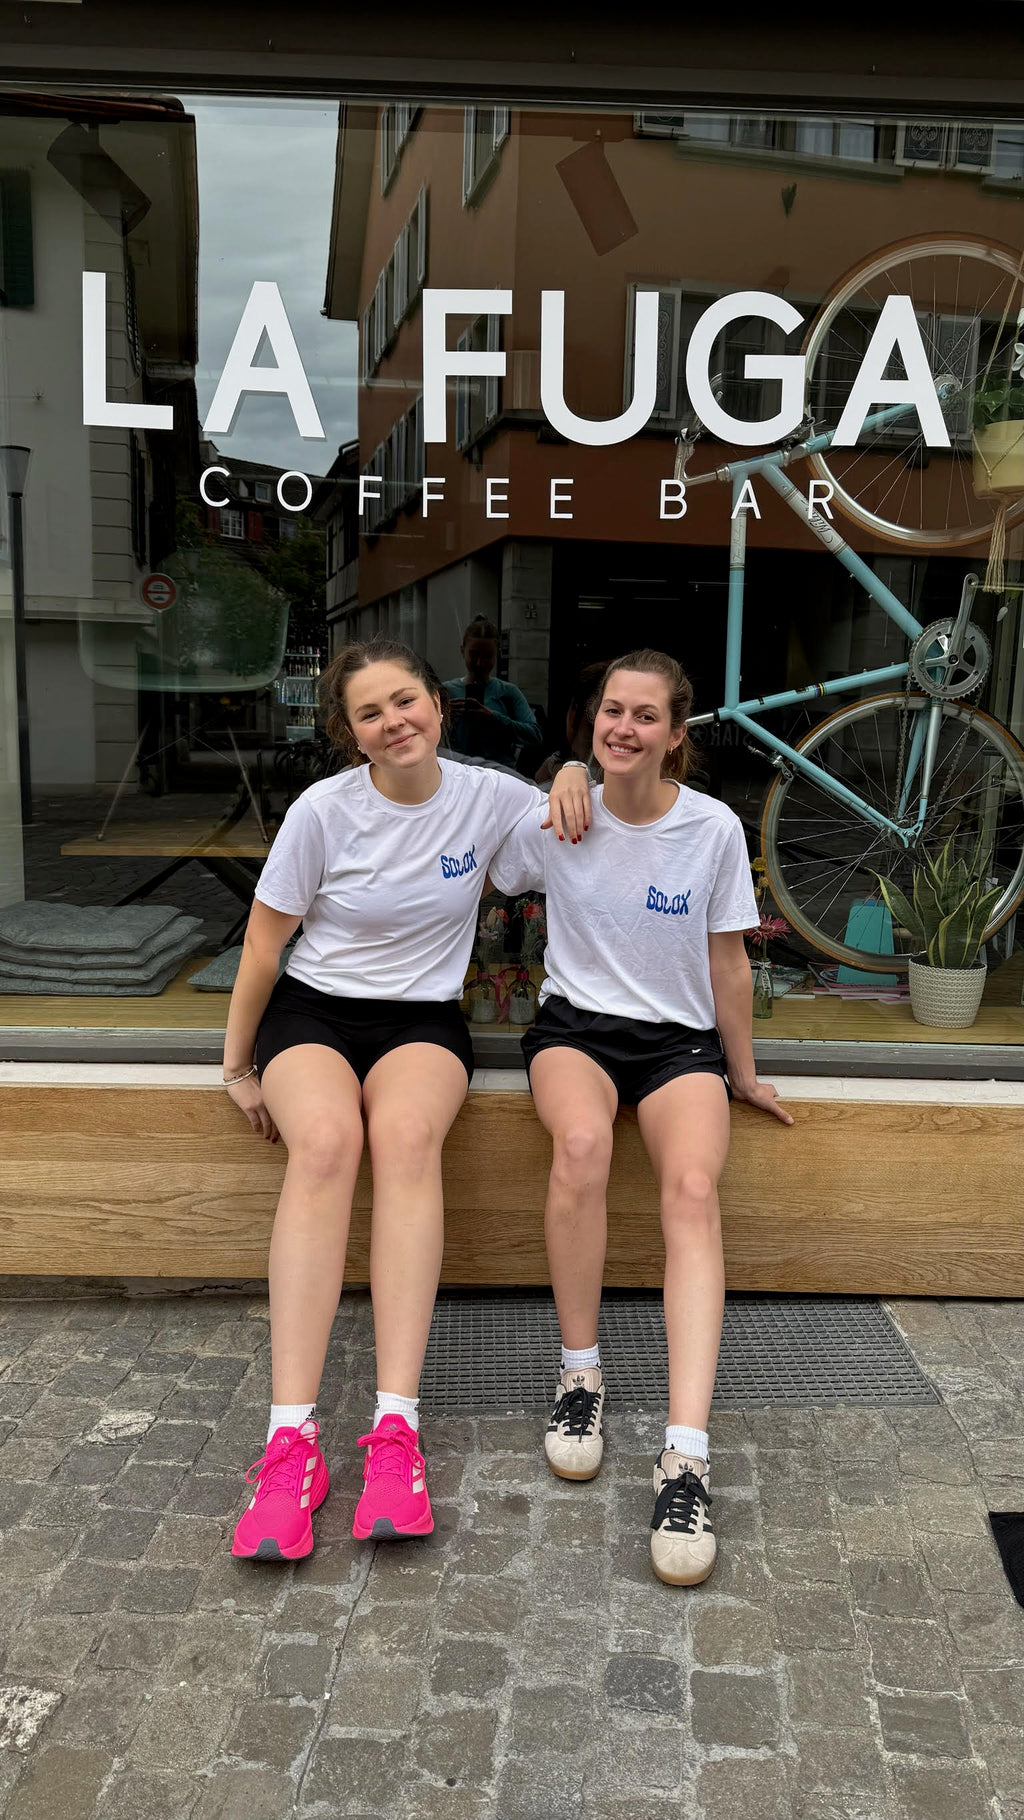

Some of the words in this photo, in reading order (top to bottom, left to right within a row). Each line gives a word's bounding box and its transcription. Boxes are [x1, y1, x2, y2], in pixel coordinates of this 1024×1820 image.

[82, 271, 326, 439] LA
[422, 289, 952, 447] FUGA
[199, 466, 574, 519] COFFEE
[659, 479, 835, 519] BAR
[440, 845, 478, 879] SOLOX
[646, 885, 692, 915] SOLOX
